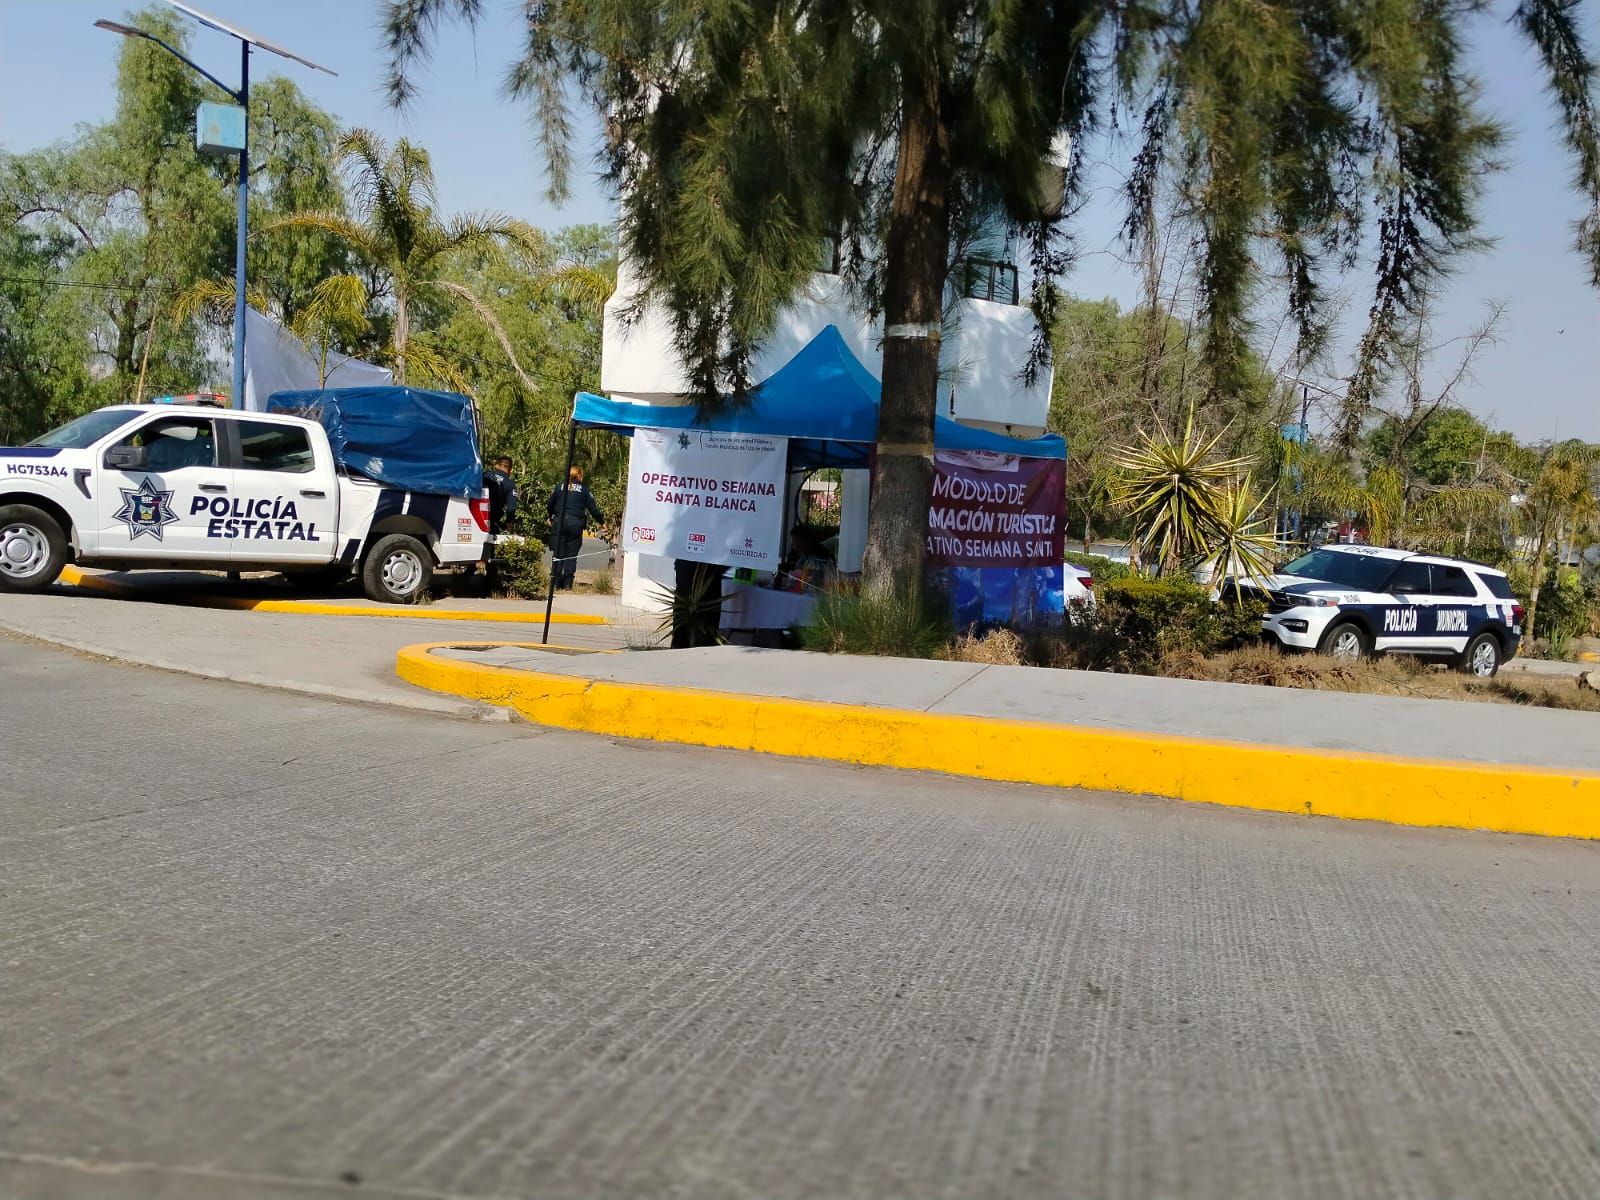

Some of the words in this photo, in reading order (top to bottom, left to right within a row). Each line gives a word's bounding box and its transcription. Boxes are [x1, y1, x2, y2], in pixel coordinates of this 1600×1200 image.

[7, 463, 68, 478] HG753A4
[641, 472, 718, 491] OPERATIVO
[721, 480, 776, 497] SEMANA
[932, 471, 1006, 503] MÓDULO
[1008, 483, 1027, 505] DE
[190, 495, 298, 520] POLICÍA
[655, 490, 701, 507] SANTA
[705, 496, 756, 512] BLANCA
[207, 518, 320, 541] ESTATAL
[929, 505, 995, 533] MACIÓN
[641, 528, 656, 540] 089
[729, 548, 768, 559] SEGURIDAD
[965, 538, 1023, 557] SEMANA
[1384, 605, 1417, 632] POLICÍA
[1436, 609, 1468, 632] MUNICIPAL
